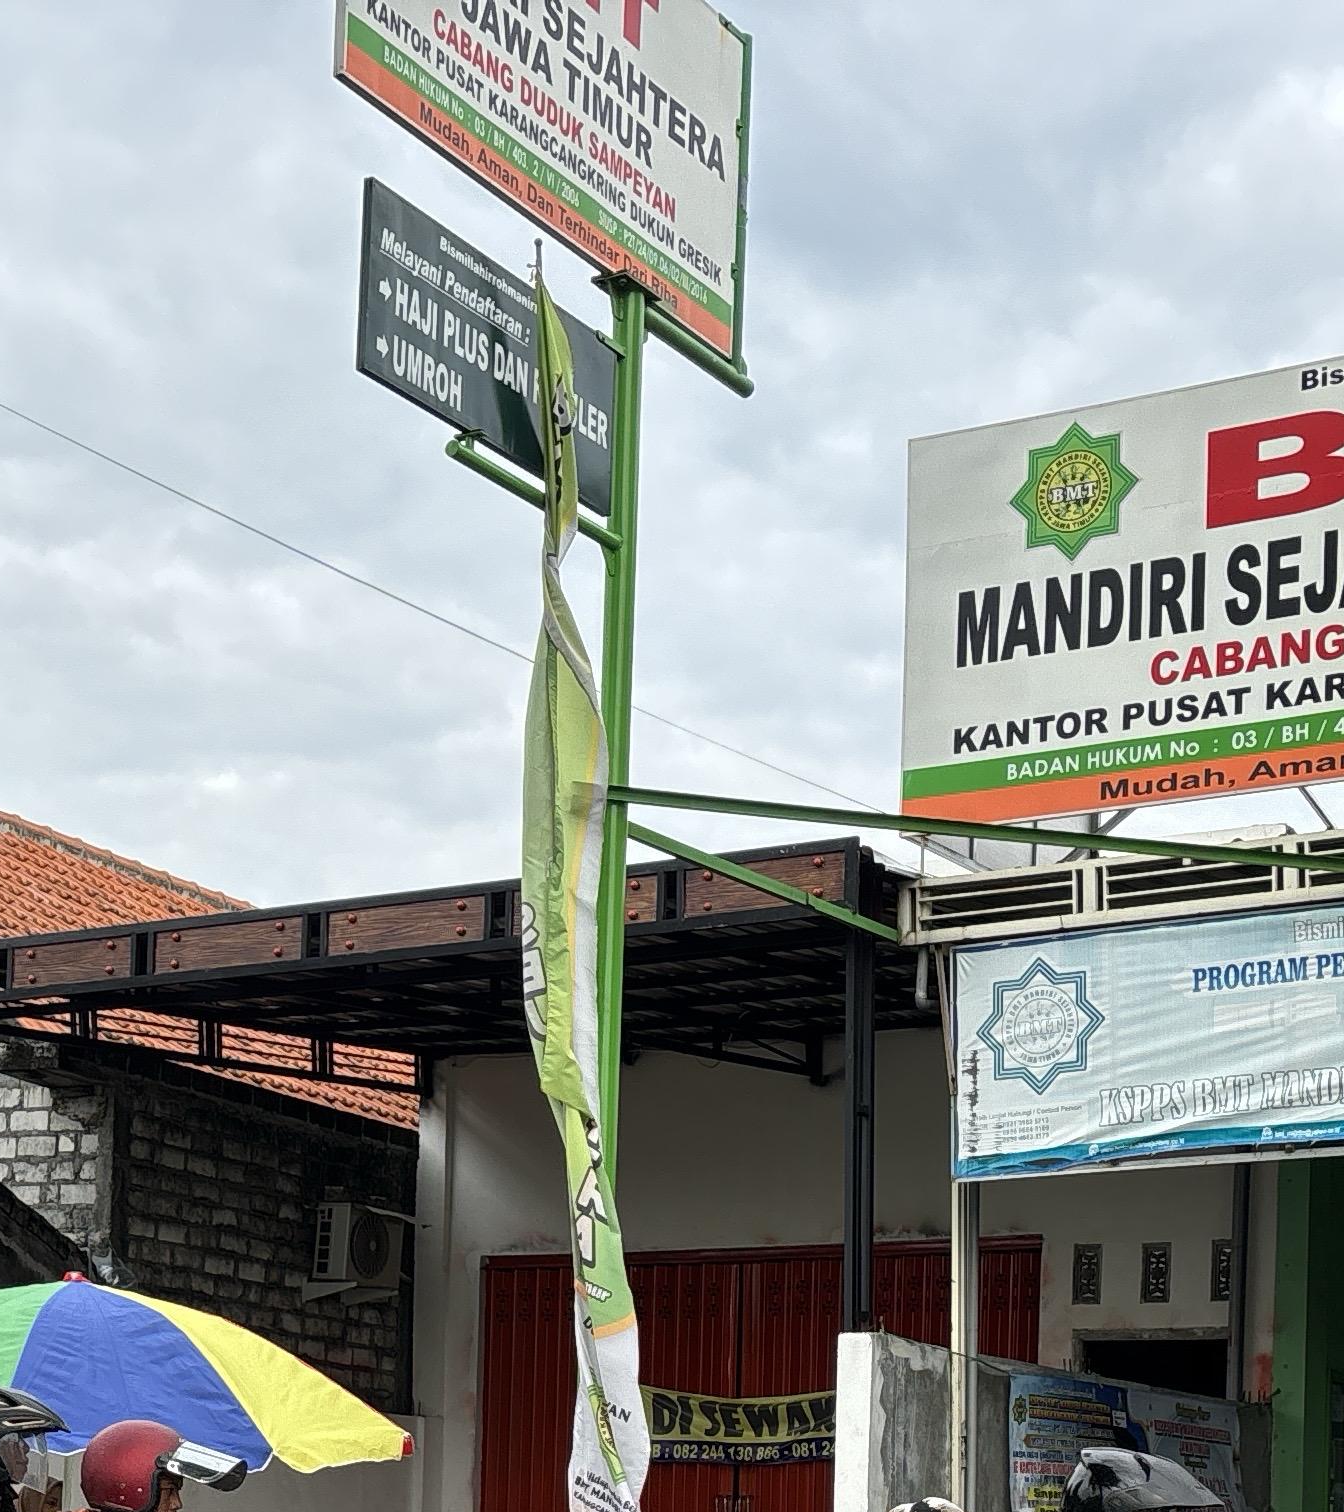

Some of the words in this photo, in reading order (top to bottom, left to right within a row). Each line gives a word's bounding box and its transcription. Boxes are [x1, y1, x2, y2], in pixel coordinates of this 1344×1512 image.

[383, 45, 417, 85] BADAN
[418, 71, 450, 112] HUKUM
[433, 8, 515, 93] CABANG
[520, 75, 584, 150] DUDUK
[588, 131, 676, 223] SAMPEYAN
[543, 0, 726, 182] SEJAHTERA
[563, 57, 652, 169] TIMUR
[366, 0, 431, 64] KANTOR
[436, 46, 484, 103] PUSAT
[488, 88, 626, 212] KARANGCANGKRING
[630, 200, 674, 251] DUKUN
[678, 238, 722, 286] GRESIK
[419, 102, 473, 162] Mudah,
[477, 148, 522, 198] Aman,
[527, 182, 554, 218] Dan
[558, 205, 620, 267] Terhindar
[380, 228, 443, 288] Melayani
[445, 272, 524, 336] Pendaftaran
[392, 334, 463, 412] UMROH
[395, 278, 438, 341] HAJI
[444, 309, 489, 372] PLUS
[494, 341, 529, 398] DAN
[1050, 482, 1097, 503] BMT
[955, 551, 1207, 669] MANDIRI
[953, 706, 1109, 756] KANTOR
[1122, 686, 1252, 732] PUSAT
[1006, 753, 1082, 782] BADAN
[1087, 744, 1164, 771] HUKUM
[1169, 736, 1200, 759] No
[1231, 729, 1258, 750] 03
[1281, 722, 1312, 745] BH
[1100, 766, 1237, 802] Mudah,
[1192, 958, 1312, 993] PROGRAM
[1098, 1080, 1187, 1128] KSPPS
[1193, 1073, 1257, 1118] BMT
[652, 1392, 694, 1435] DI
[698, 1396, 836, 1438] SEWAK
[673, 1443, 697, 1458] 082
